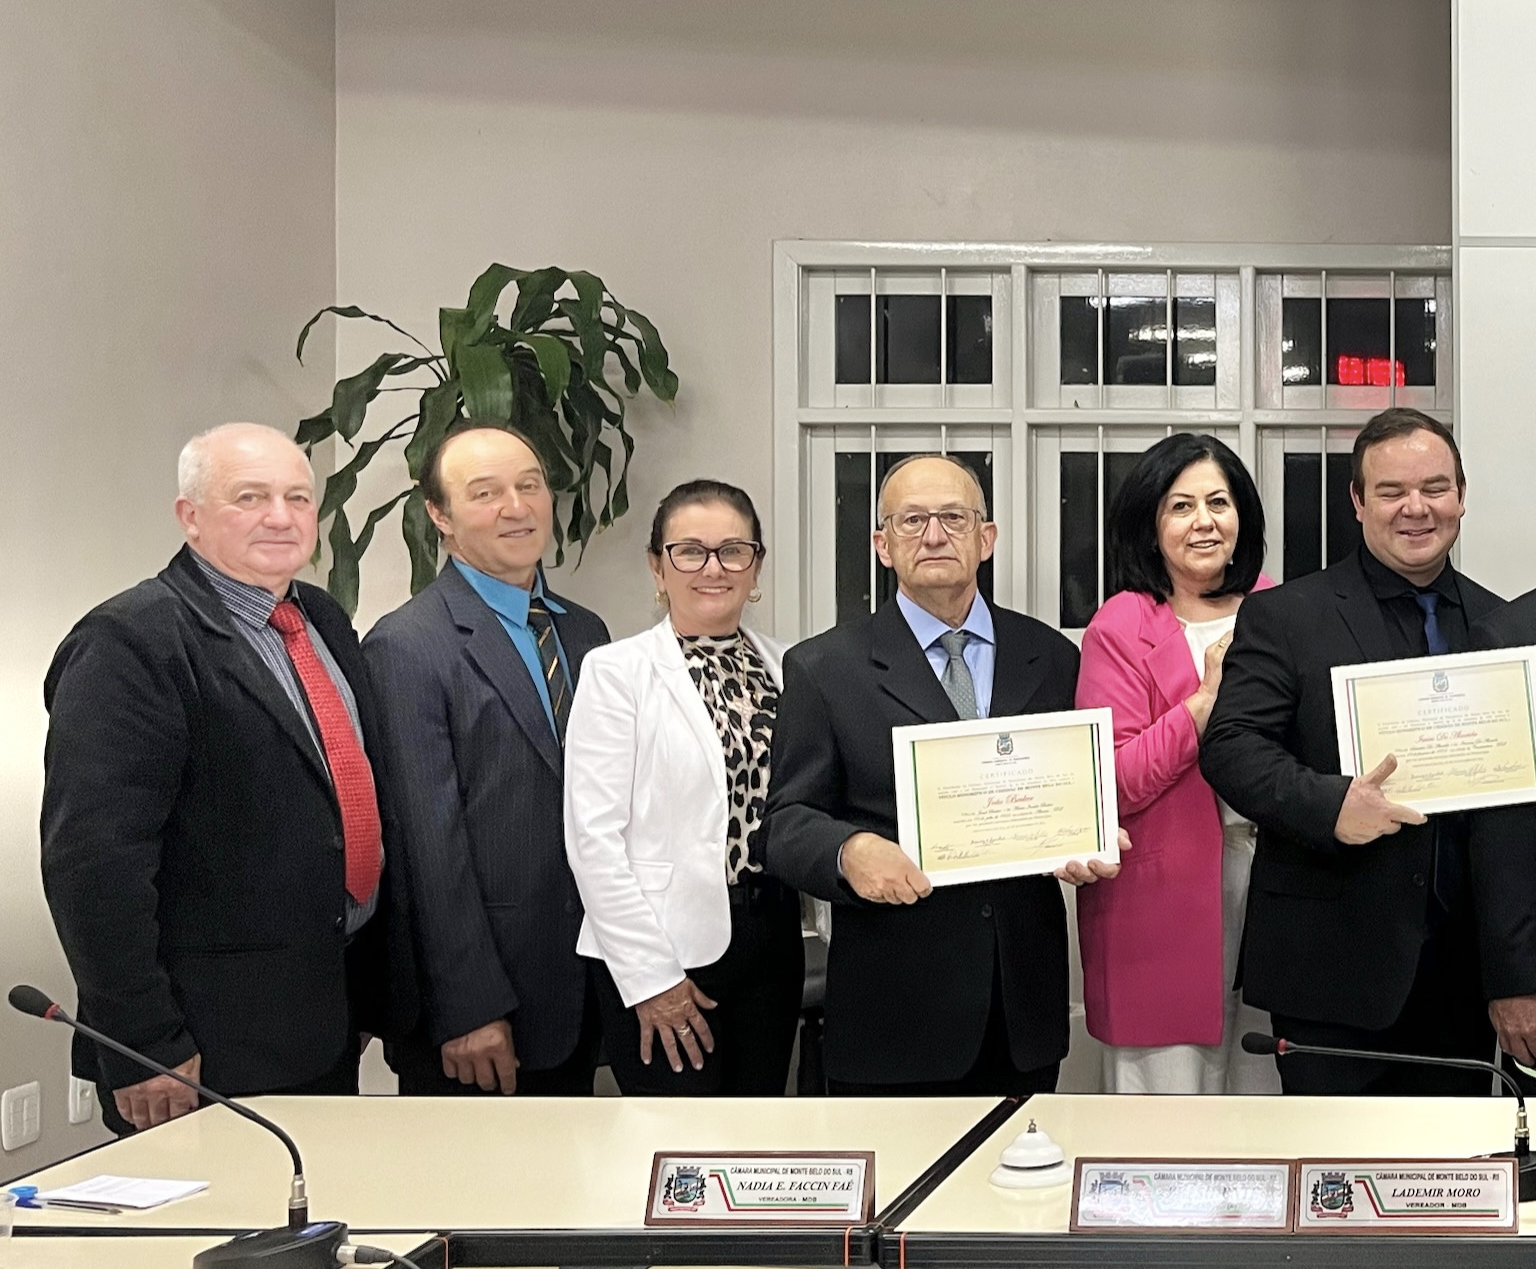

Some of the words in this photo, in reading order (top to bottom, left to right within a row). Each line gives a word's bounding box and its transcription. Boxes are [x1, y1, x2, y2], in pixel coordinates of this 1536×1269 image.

[730, 1167, 752, 1175] CÂMARA
[1375, 1172, 1398, 1180] CÂMARA
[736, 1181, 773, 1191] NADIA
[776, 1181, 786, 1191] E.
[789, 1181, 830, 1191] FACCIN
[831, 1180, 854, 1191] FAÉ
[1392, 1188, 1444, 1197] LADEMIR
[1446, 1188, 1481, 1197] MORO
